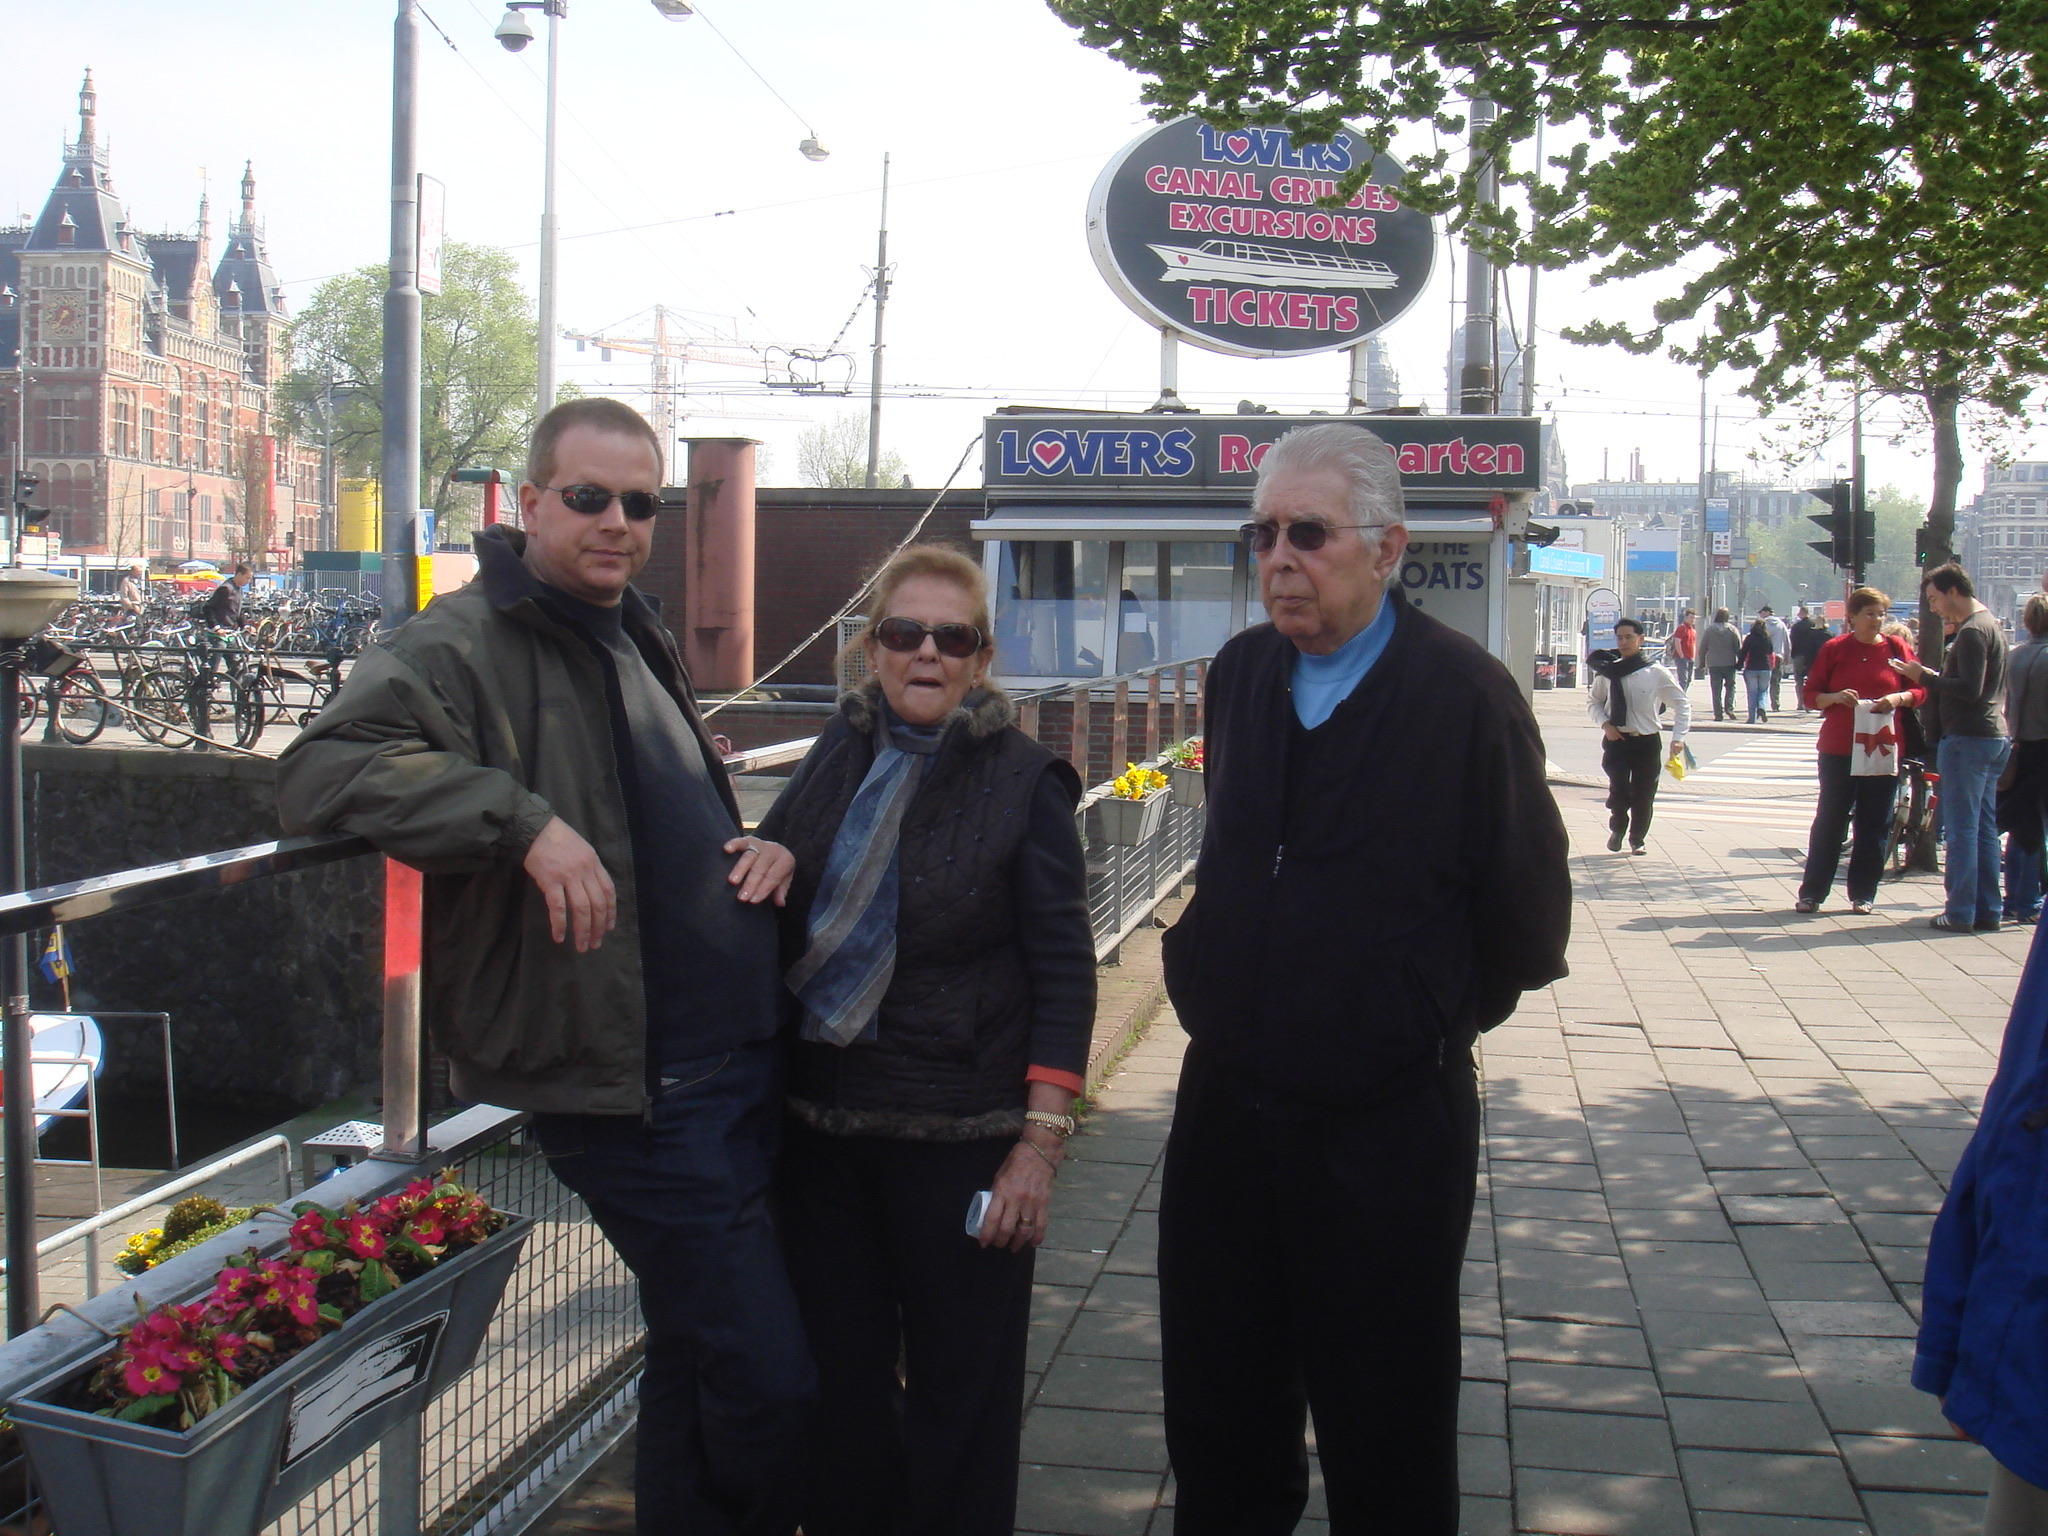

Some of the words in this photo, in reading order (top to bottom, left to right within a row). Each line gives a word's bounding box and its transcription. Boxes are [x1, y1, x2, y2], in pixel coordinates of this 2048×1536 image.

[1197, 124, 1352, 173] LOVERS
[1145, 166, 1262, 200] CANAL
[1270, 175, 1400, 212] CRUSES
[1169, 202, 1376, 245] EXCURSIONS
[1187, 287, 1359, 332] TICKETS
[997, 427, 1196, 478] LOVERS
[1400, 561, 1484, 590] OATS
